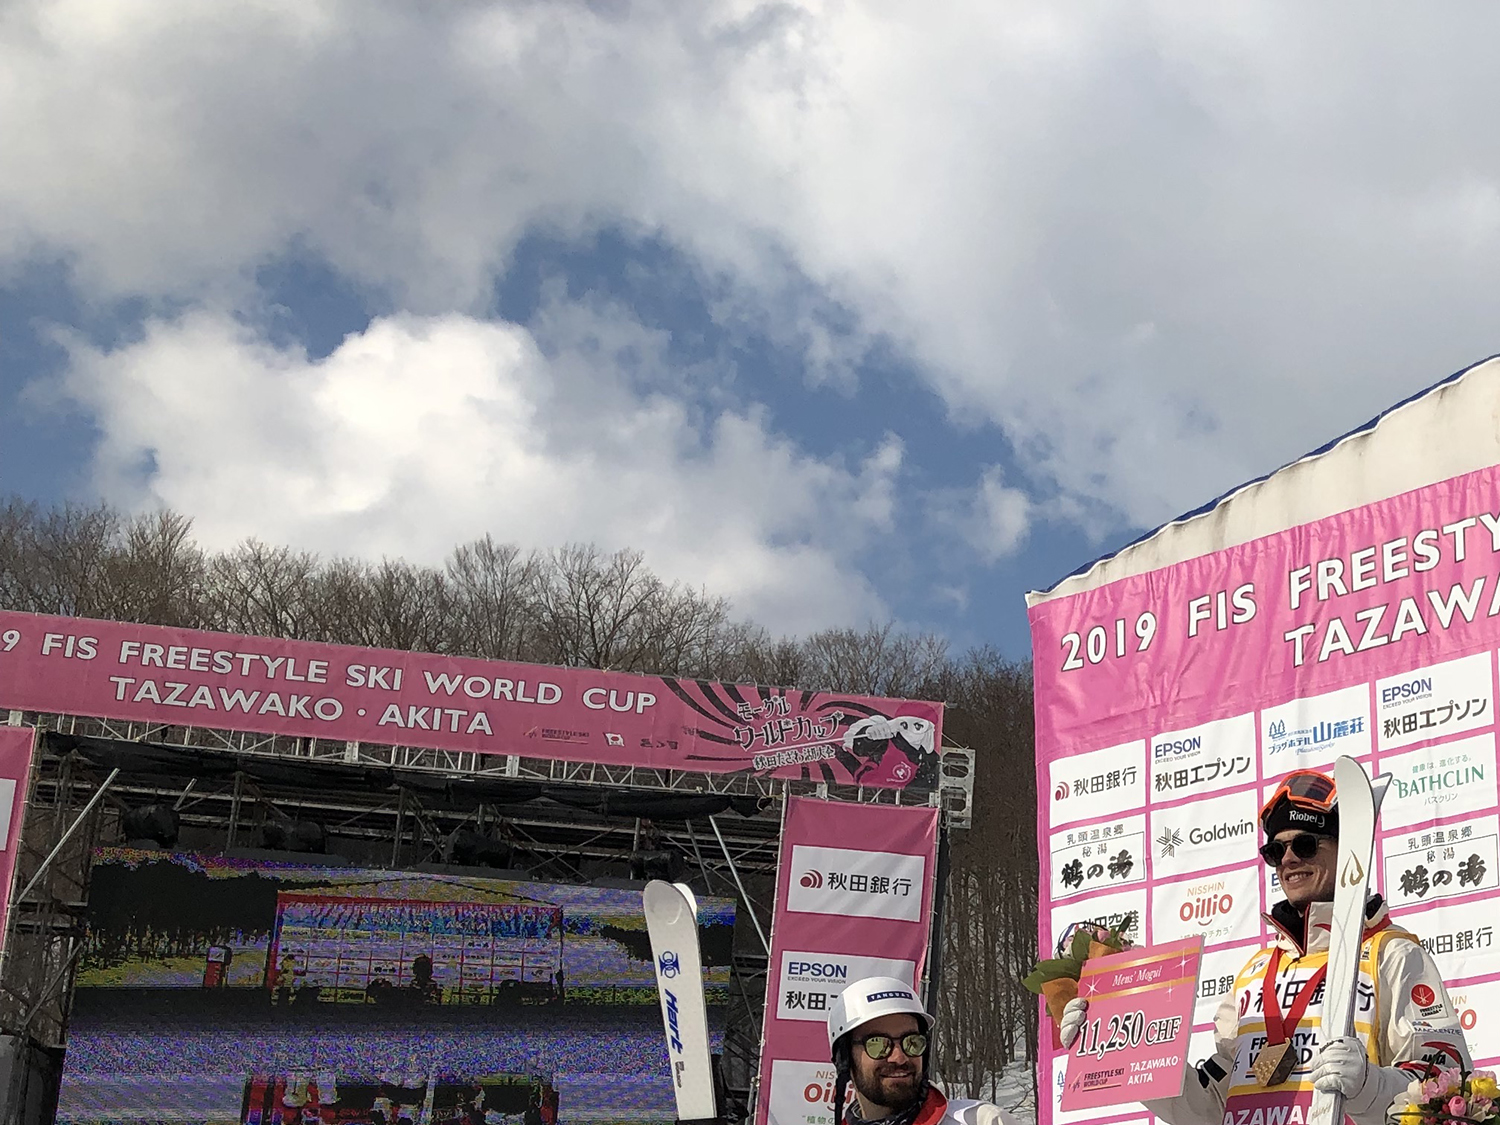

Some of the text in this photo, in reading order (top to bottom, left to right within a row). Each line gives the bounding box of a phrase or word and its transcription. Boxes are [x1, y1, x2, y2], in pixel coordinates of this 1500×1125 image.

[1060, 611, 1157, 673] 2019
[1187, 581, 1257, 640] FIS
[42, 632, 98, 660] FIS
[119, 641, 329, 684] FREESTYLE
[346, 664, 403, 691] SKI
[423, 670, 562, 705] WORLD
[582, 687, 657, 714] CUP
[1382, 677, 1432, 704] EPSON
[109, 677, 494, 736] TAZAWAKO AKITA
[1383, 698, 1487, 738] 秋田エプソン
[1155, 736, 1201, 759] EPSON
[1073, 766, 1137, 797] 秋田銀行
[1155, 756, 1251, 792] 秋田エプソン
[1392, 764, 1484, 799] BATHCLIN
[1424, 792, 1459, 806] バスクリン
[1067, 824, 1124, 845] 乳頭温泉郷
[1190, 819, 1254, 845] Goldwin
[1407, 825, 1473, 850] 乳頭温泉郷
[827, 872, 912, 896] 秋田銀行
[1187, 881, 1225, 897] NISSHIN
[1420, 926, 1493, 957] 秋田銀行
[788, 962, 847, 978] EPSON
[1077, 1010, 1183, 1061] 11,250 CHF
[1127, 1072, 1154, 1086] AKITA
